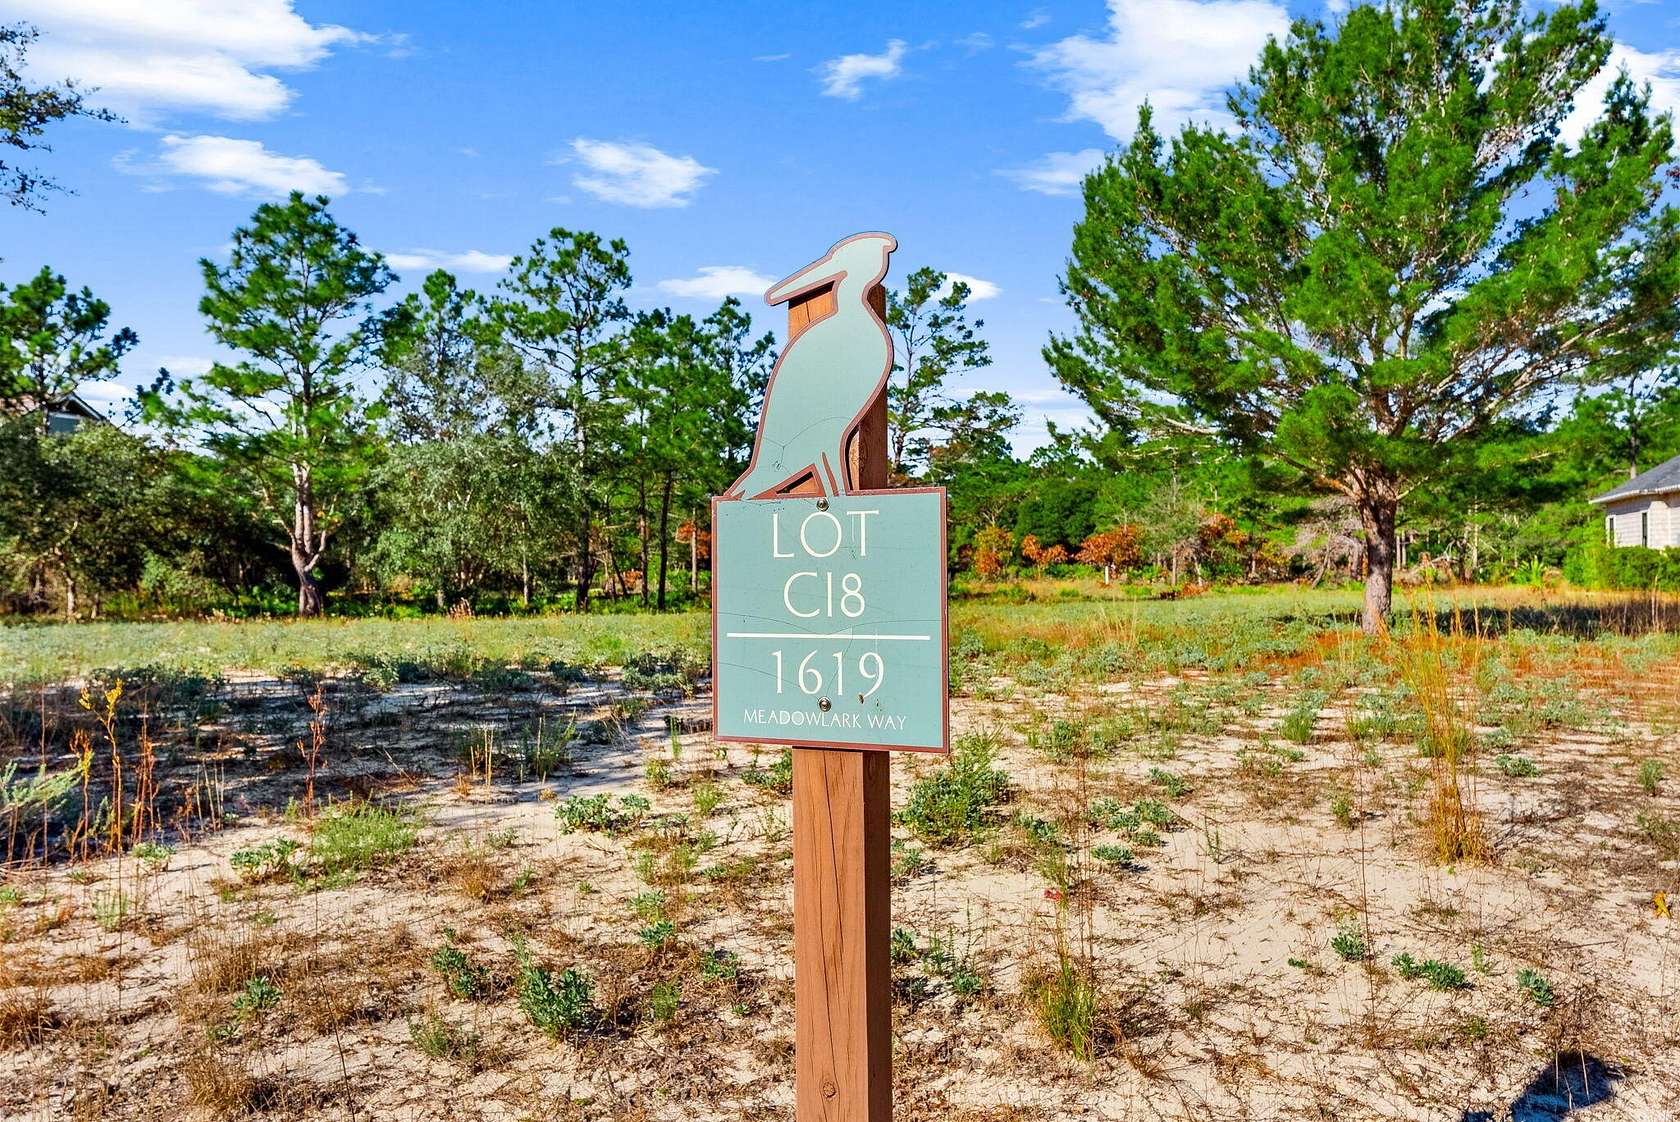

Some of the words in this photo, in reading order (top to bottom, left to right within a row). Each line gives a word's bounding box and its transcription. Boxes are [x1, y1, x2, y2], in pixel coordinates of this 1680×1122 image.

[772, 509, 880, 559] LOT
[771, 649, 885, 699] 1619
[743, 708, 862, 729] MEADOWLARK
[867, 714, 907, 730] WAY
